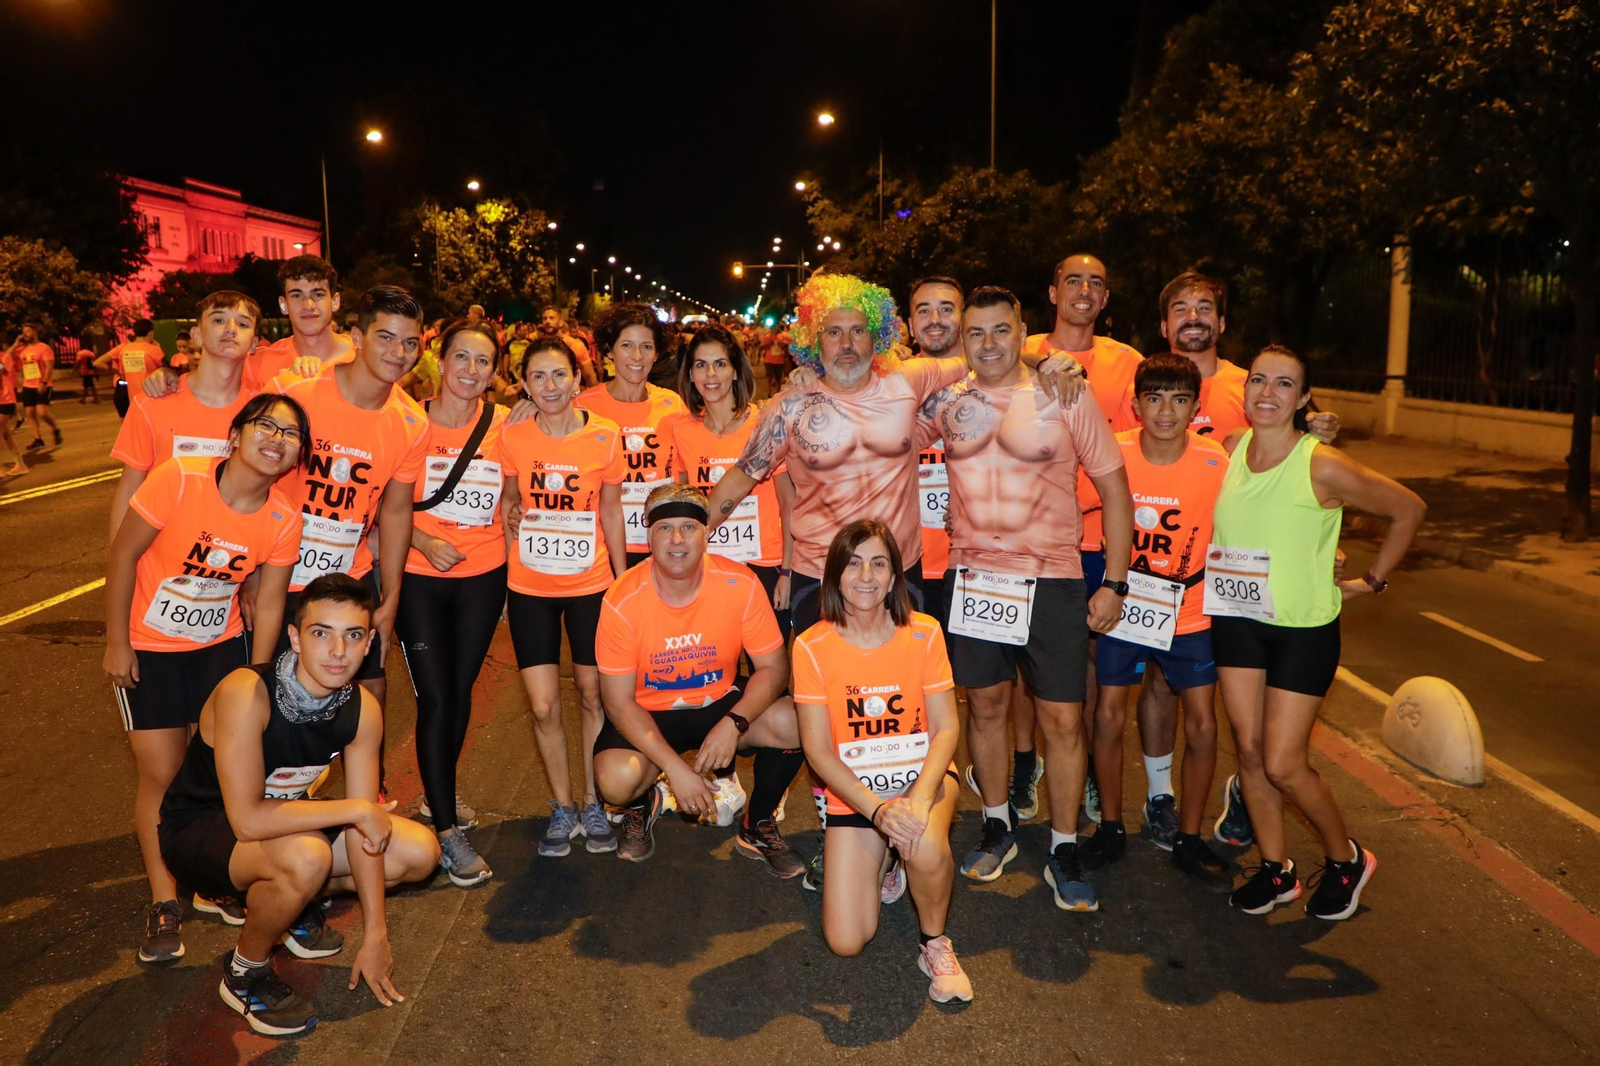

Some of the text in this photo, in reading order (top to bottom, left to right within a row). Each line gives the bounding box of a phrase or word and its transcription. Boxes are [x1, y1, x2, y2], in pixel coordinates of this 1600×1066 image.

[314, 439, 331, 451] 36
[435, 446, 447, 454] 36
[533, 461, 579, 472] 36 CARRERA
[624, 452, 657, 470] UR
[698, 456, 709, 464] 36
[305, 480, 357, 510] TUR
[529, 492, 575, 510] TUR
[1132, 493, 1180, 506] CARRERA
[198, 531, 249, 553] 36 CARRERA
[525, 536, 590, 558] 13139
[1132, 529, 1172, 555] UR
[1214, 577, 1261, 601] 8308
[160, 600, 226, 627] 18008
[963, 597, 1019, 625] 8299
[664, 633, 702, 650] XXXV
[650, 646, 717, 658] CARRERA NOCTURNA
[655, 651, 717, 665] GUADALQUIVIR
[846, 684, 901, 696] 36 CARRERA
[848, 718, 901, 738] TUR
[846, 749, 862, 757] K7
